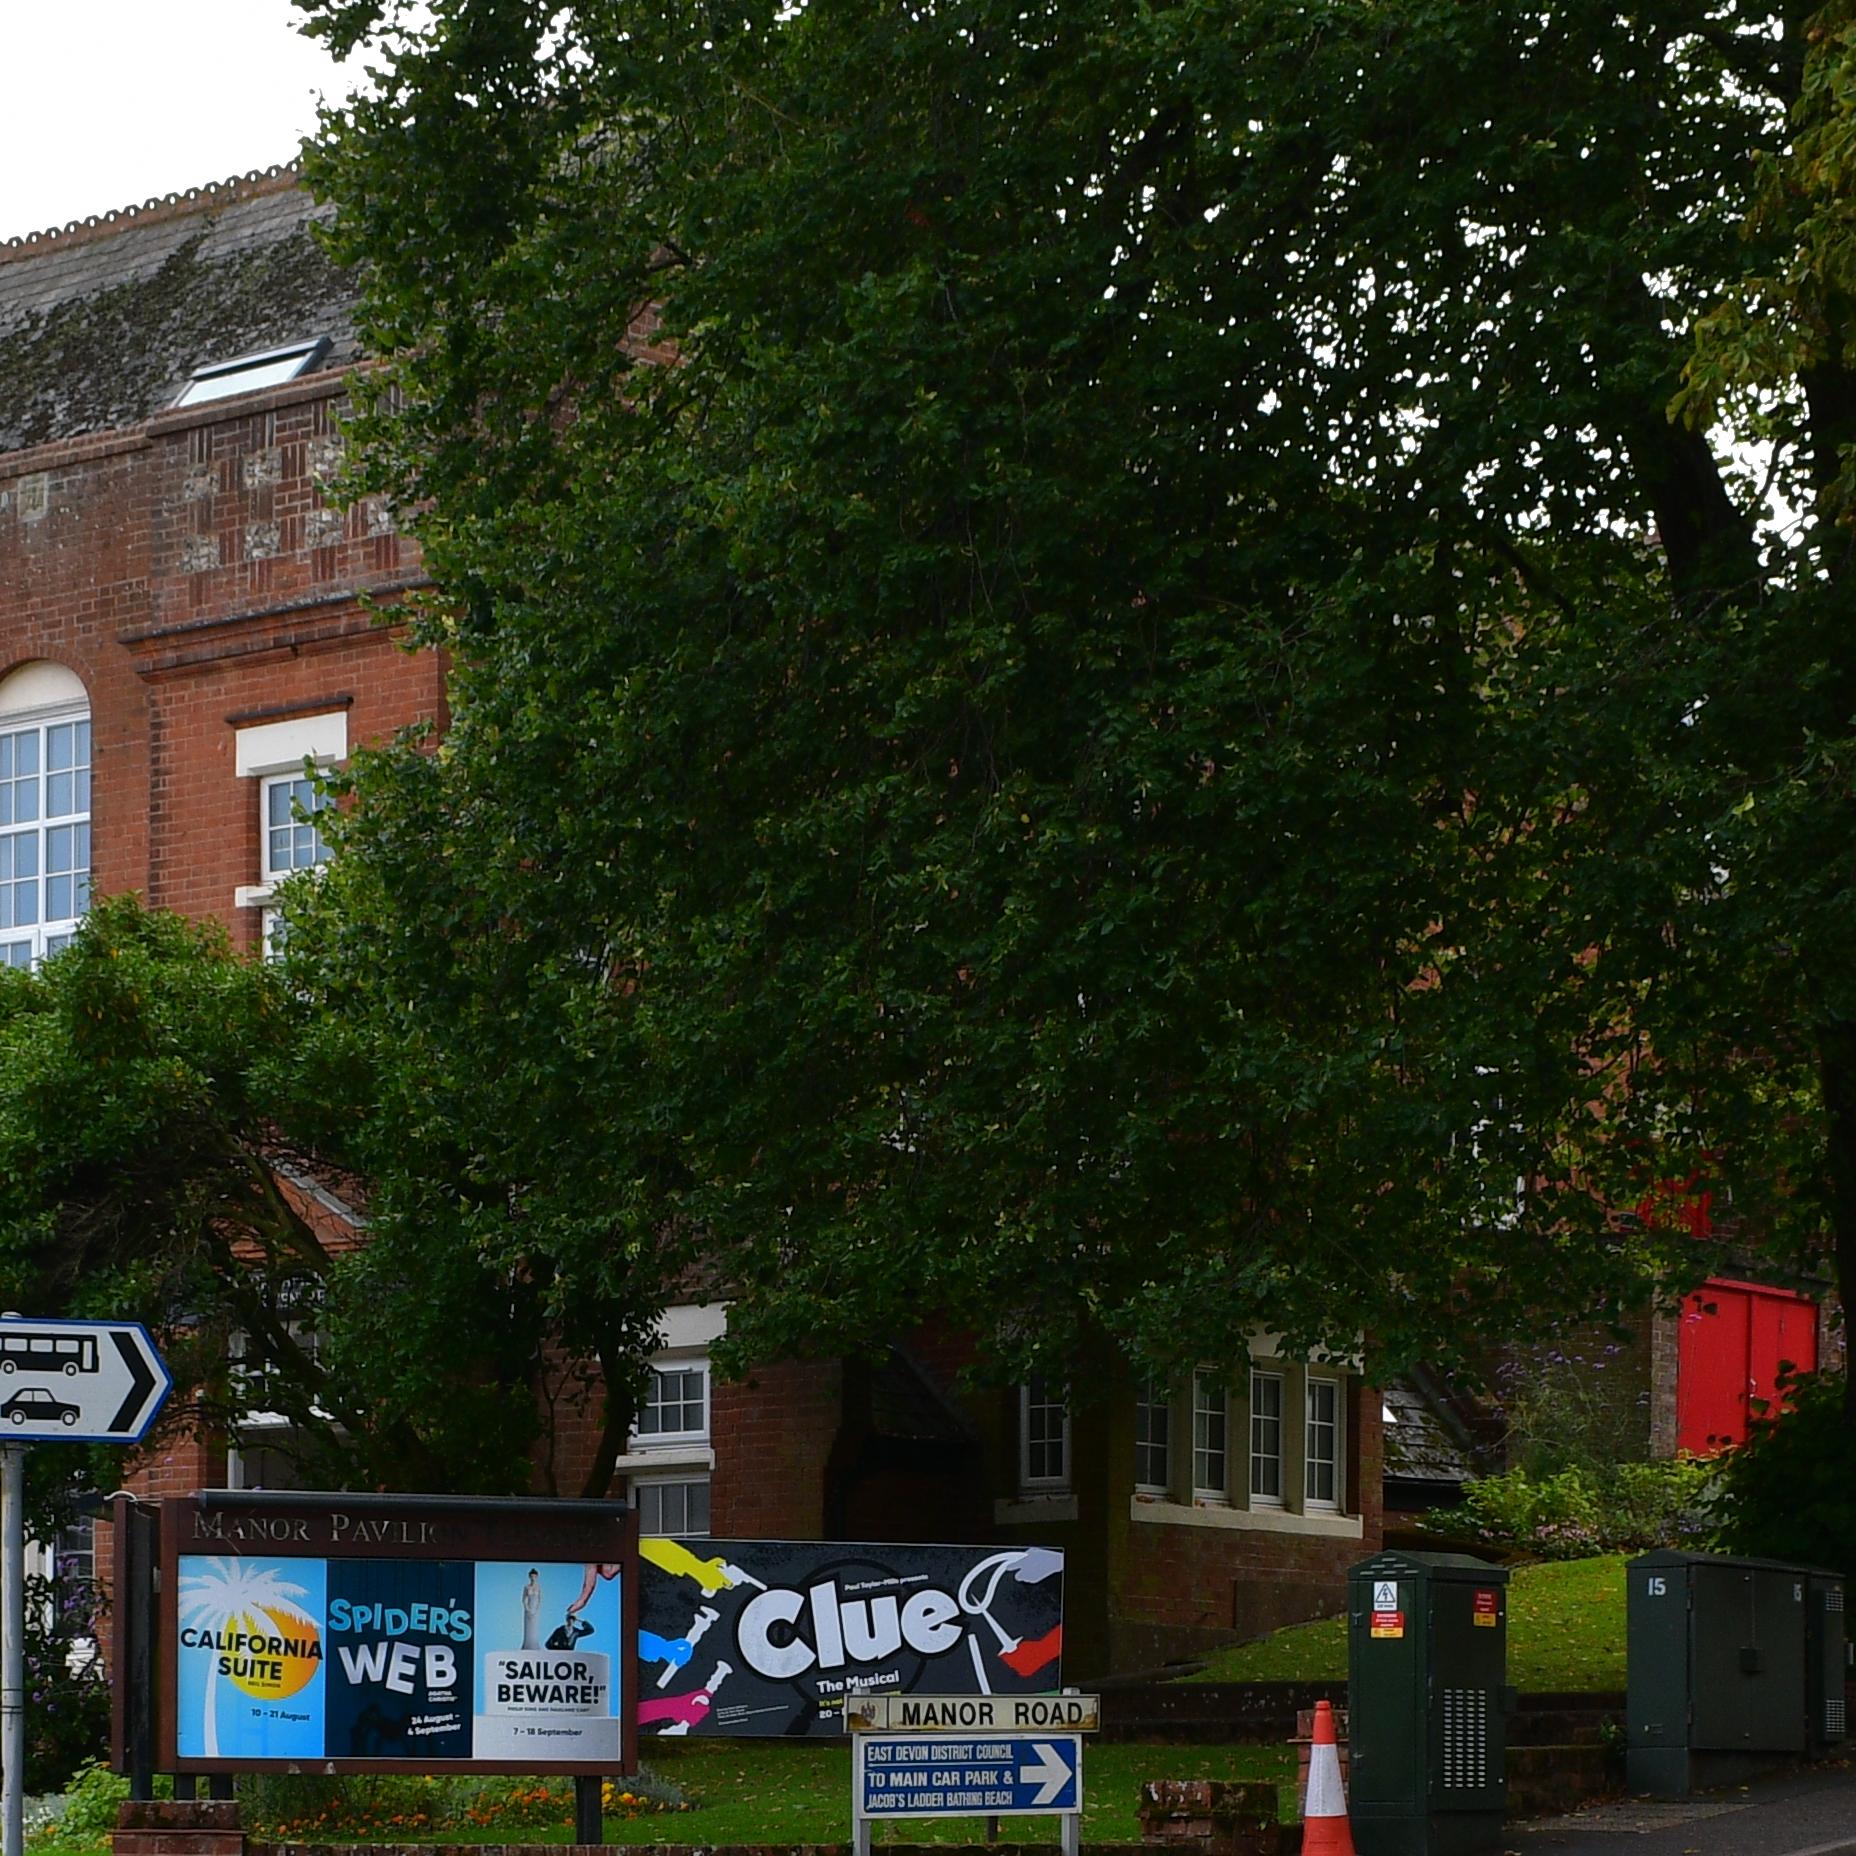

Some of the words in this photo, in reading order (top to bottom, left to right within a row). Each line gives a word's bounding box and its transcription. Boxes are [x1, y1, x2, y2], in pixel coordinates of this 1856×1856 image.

[192, 1510, 311, 1542] MANOR
[1648, 1578, 1666, 1596] 15
[328, 1598, 473, 1642] SPIDER'S
[737, 1580, 963, 1679] Clue
[180, 1628, 323, 1660] CALIFORNIA
[218, 1656, 283, 1680] SUITE
[338, 1641, 457, 1694] WEB
[816, 1678, 844, 1694] The
[846, 1670, 900, 1689] Musical
[251, 1708, 261, 1716] 10
[280, 1710, 311, 1721] August
[424, 1713, 453, 1724] August
[818, 1709, 832, 1719] 20
[902, 1702, 994, 1725] MANOR
[1014, 1702, 1083, 1725] ROAD
[415, 1723, 461, 1735] September
[513, 1727, 518, 1735] 7
[537, 1728, 583, 1737] September
[867, 1745, 892, 1762] EAST
[897, 1745, 928, 1761] DEVON
[931, 1744, 974, 1760] DISTRICT
[976, 1743, 1014, 1759] COUNCIL
[867, 1772, 885, 1787] TO
[890, 1771, 927, 1787] MAIN
[932, 1771, 961, 1786] CAR
[965, 1770, 998, 1785] PARK
[1003, 1770, 1013, 1784] &
[867, 1792, 905, 1808] JACOB'S
[908, 1792, 944, 1807] LADDER
[946, 1791, 982, 1806] BATHING
[985, 1790, 1012, 1805] BEACH
